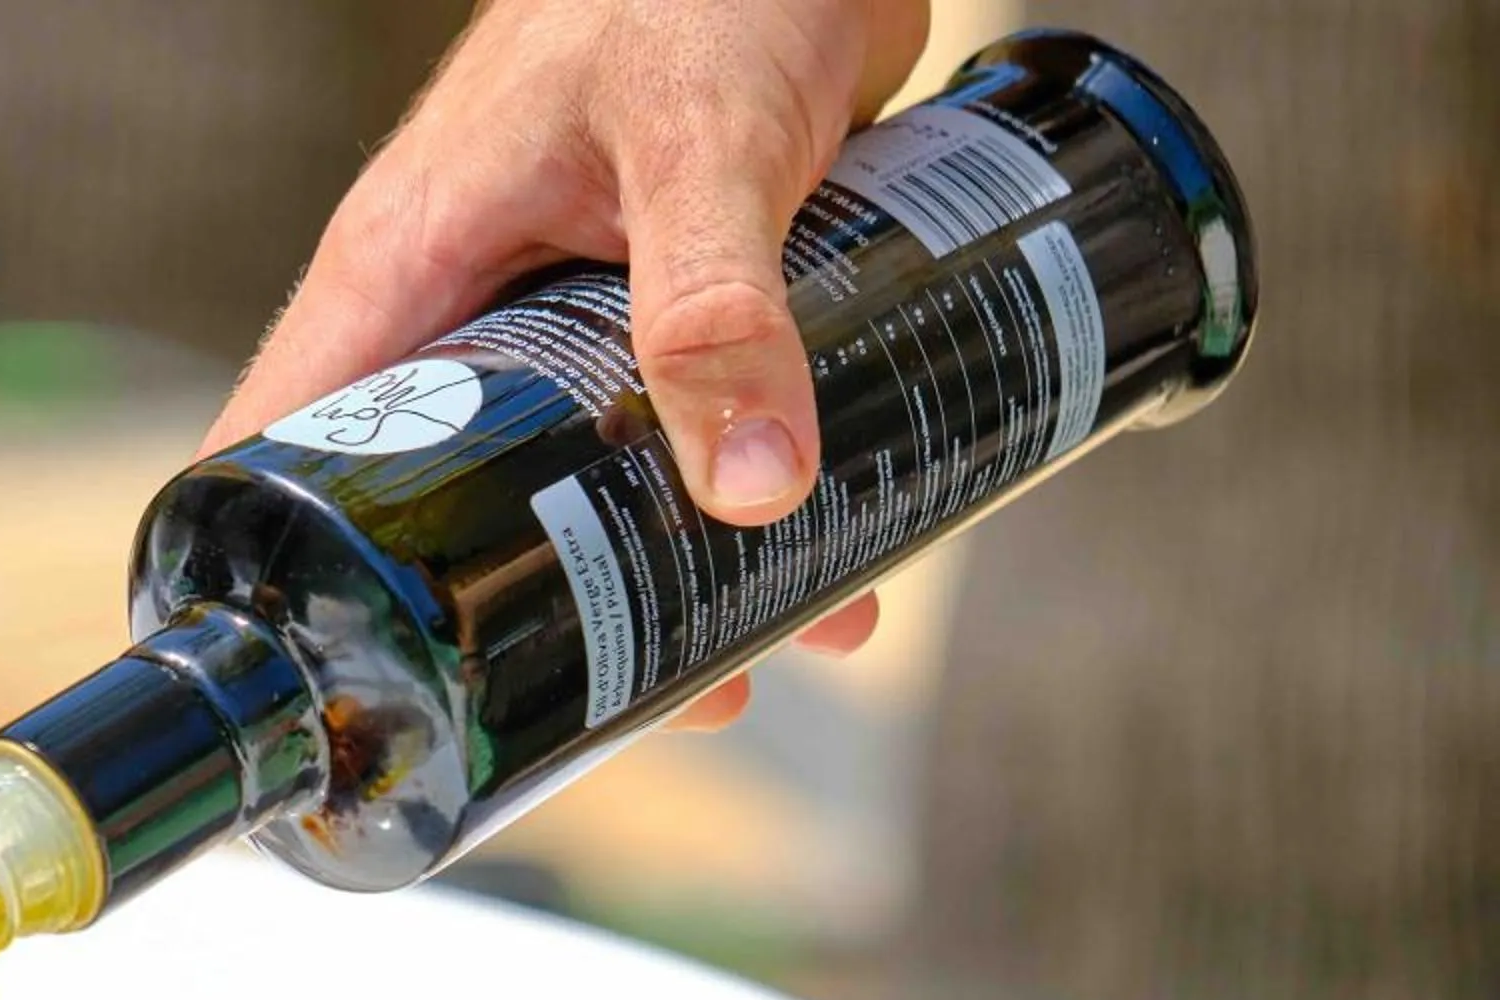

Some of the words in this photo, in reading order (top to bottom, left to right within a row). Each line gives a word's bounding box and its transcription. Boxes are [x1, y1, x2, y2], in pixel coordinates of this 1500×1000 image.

[538, 349, 568, 373] oliva
[563, 364, 582, 382] de
[553, 376, 571, 392] de
[577, 375, 614, 409] Aceite
[567, 386, 603, 420] Aceite
[560, 525, 591, 577] Extra
[591, 552, 619, 610] Picual
[579, 576, 609, 633] Verge
[593, 632, 609, 692] d'Oliva
[609, 623, 628, 708] Arbequina
[593, 695, 607, 718] Oli
